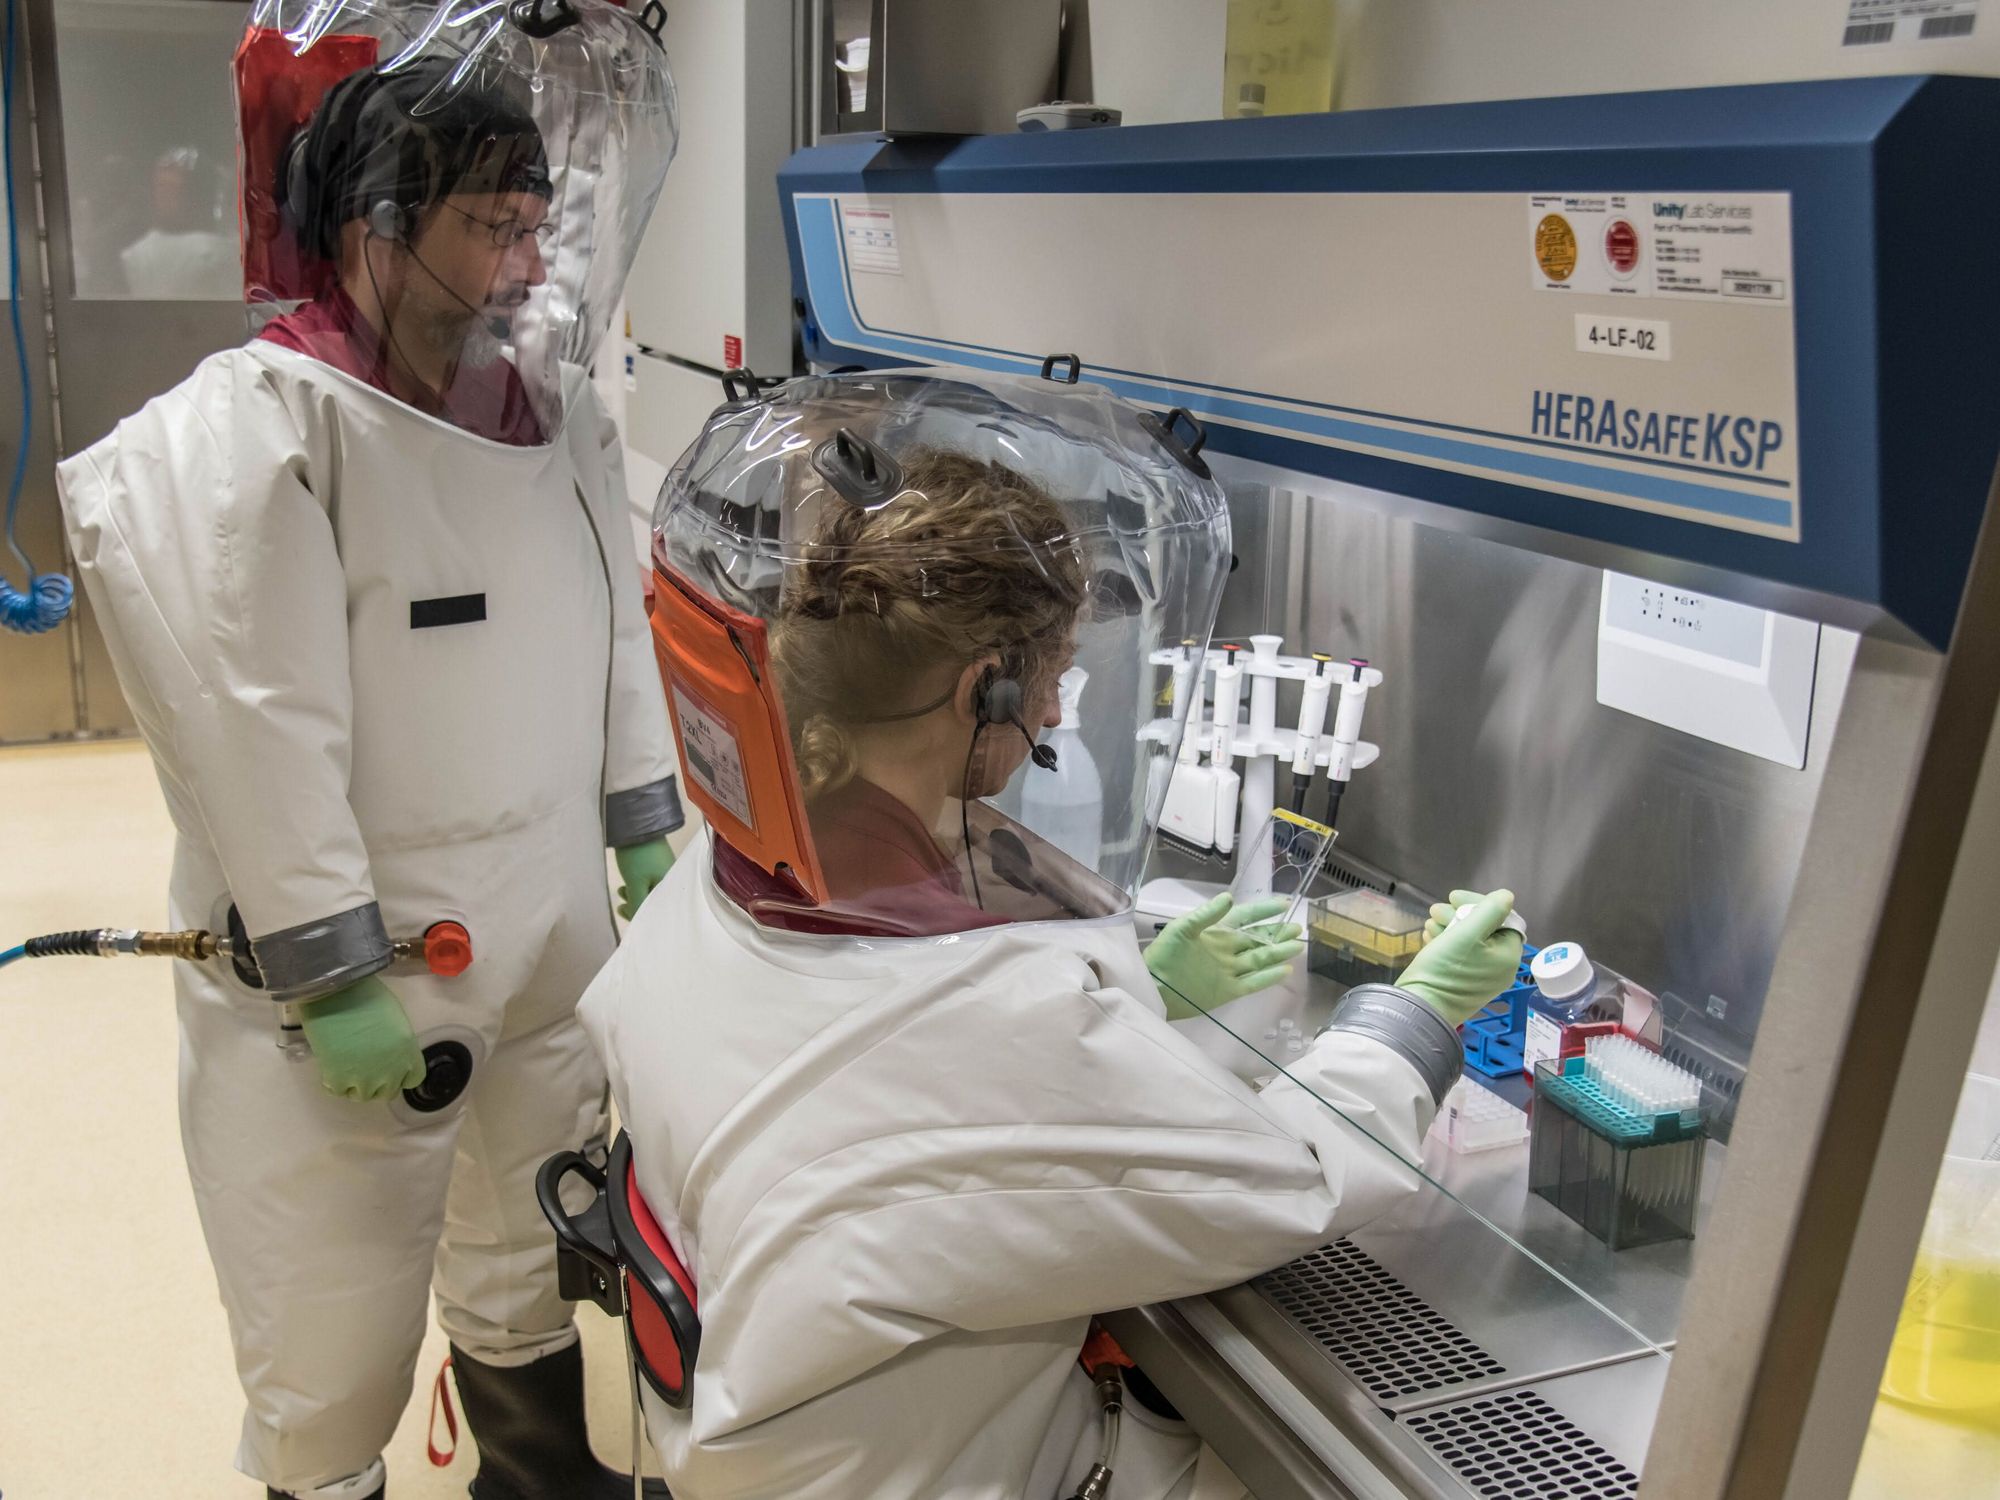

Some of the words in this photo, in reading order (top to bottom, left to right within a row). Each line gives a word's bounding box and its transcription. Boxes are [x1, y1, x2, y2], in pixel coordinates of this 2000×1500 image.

[1653, 202, 1685, 220] Unity
[1687, 205, 1705, 219] Lab
[1706, 204, 1752, 220] Services
[1588, 325, 1656, 351] 4-LF-02
